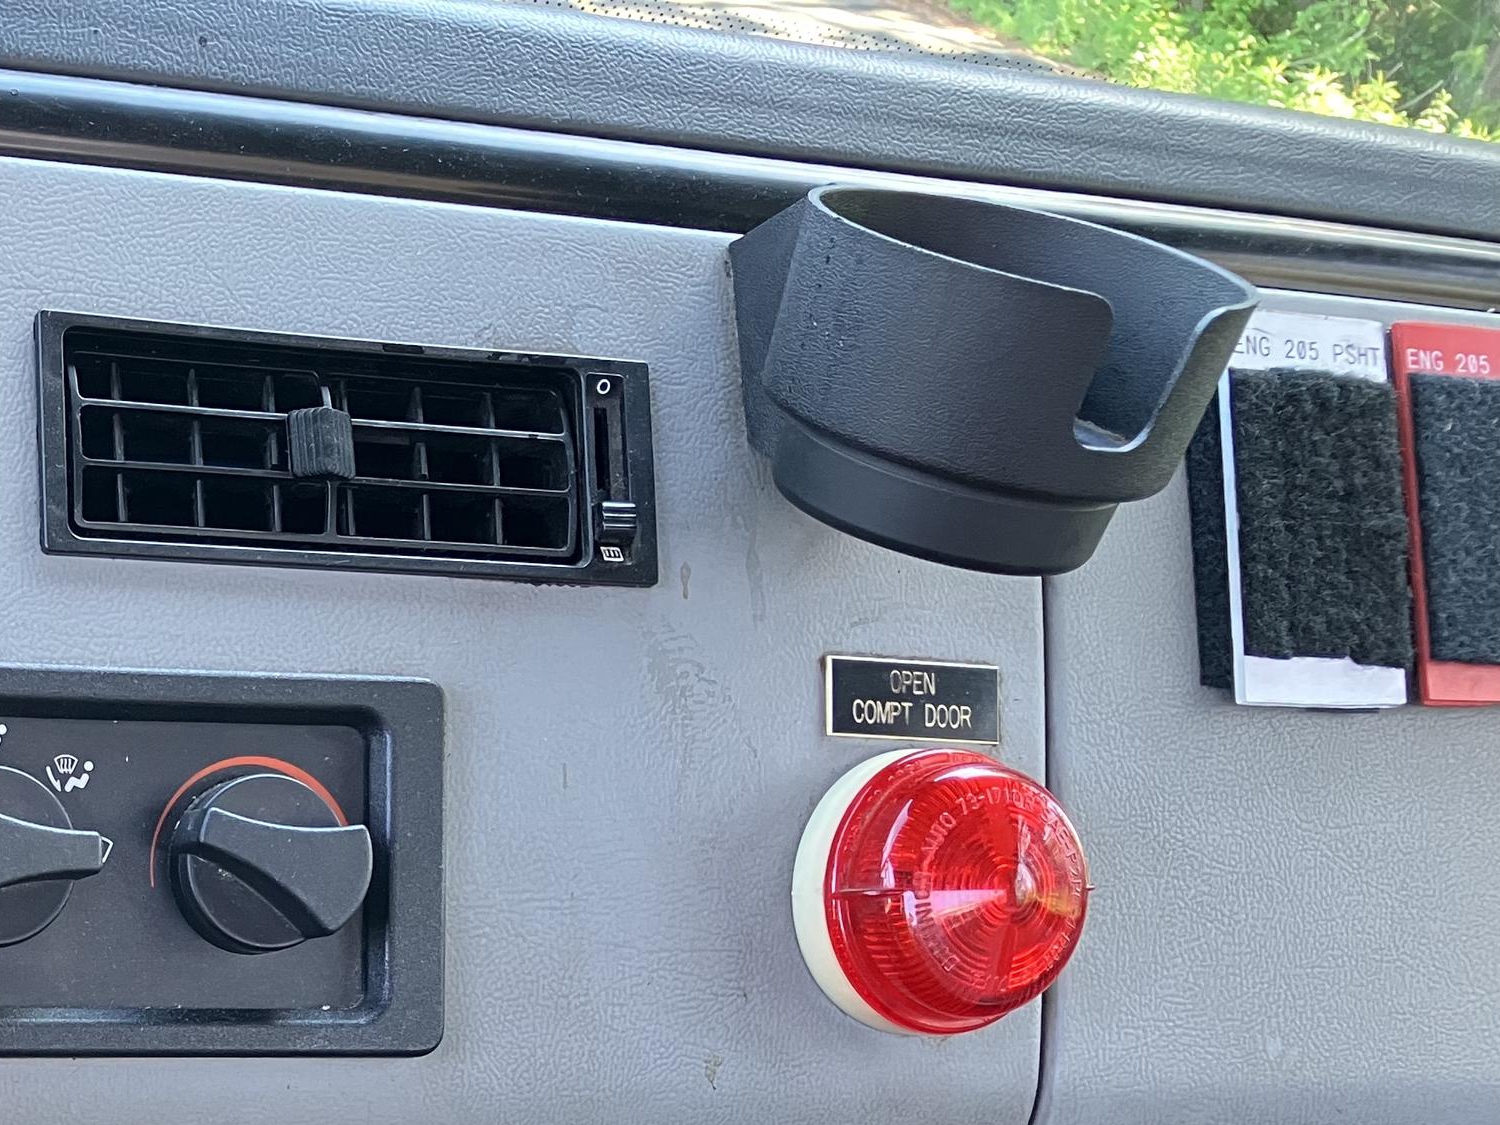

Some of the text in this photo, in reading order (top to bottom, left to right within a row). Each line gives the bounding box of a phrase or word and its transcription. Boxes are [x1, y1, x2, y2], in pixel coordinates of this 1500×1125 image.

[1285, 340, 1318, 360] 205
[1333, 344, 1380, 366] PSHT
[1407, 349, 1490, 374] ENG 205
[890, 670, 936, 696] OPEN
[852, 699, 972, 730] COMPT DOOR
